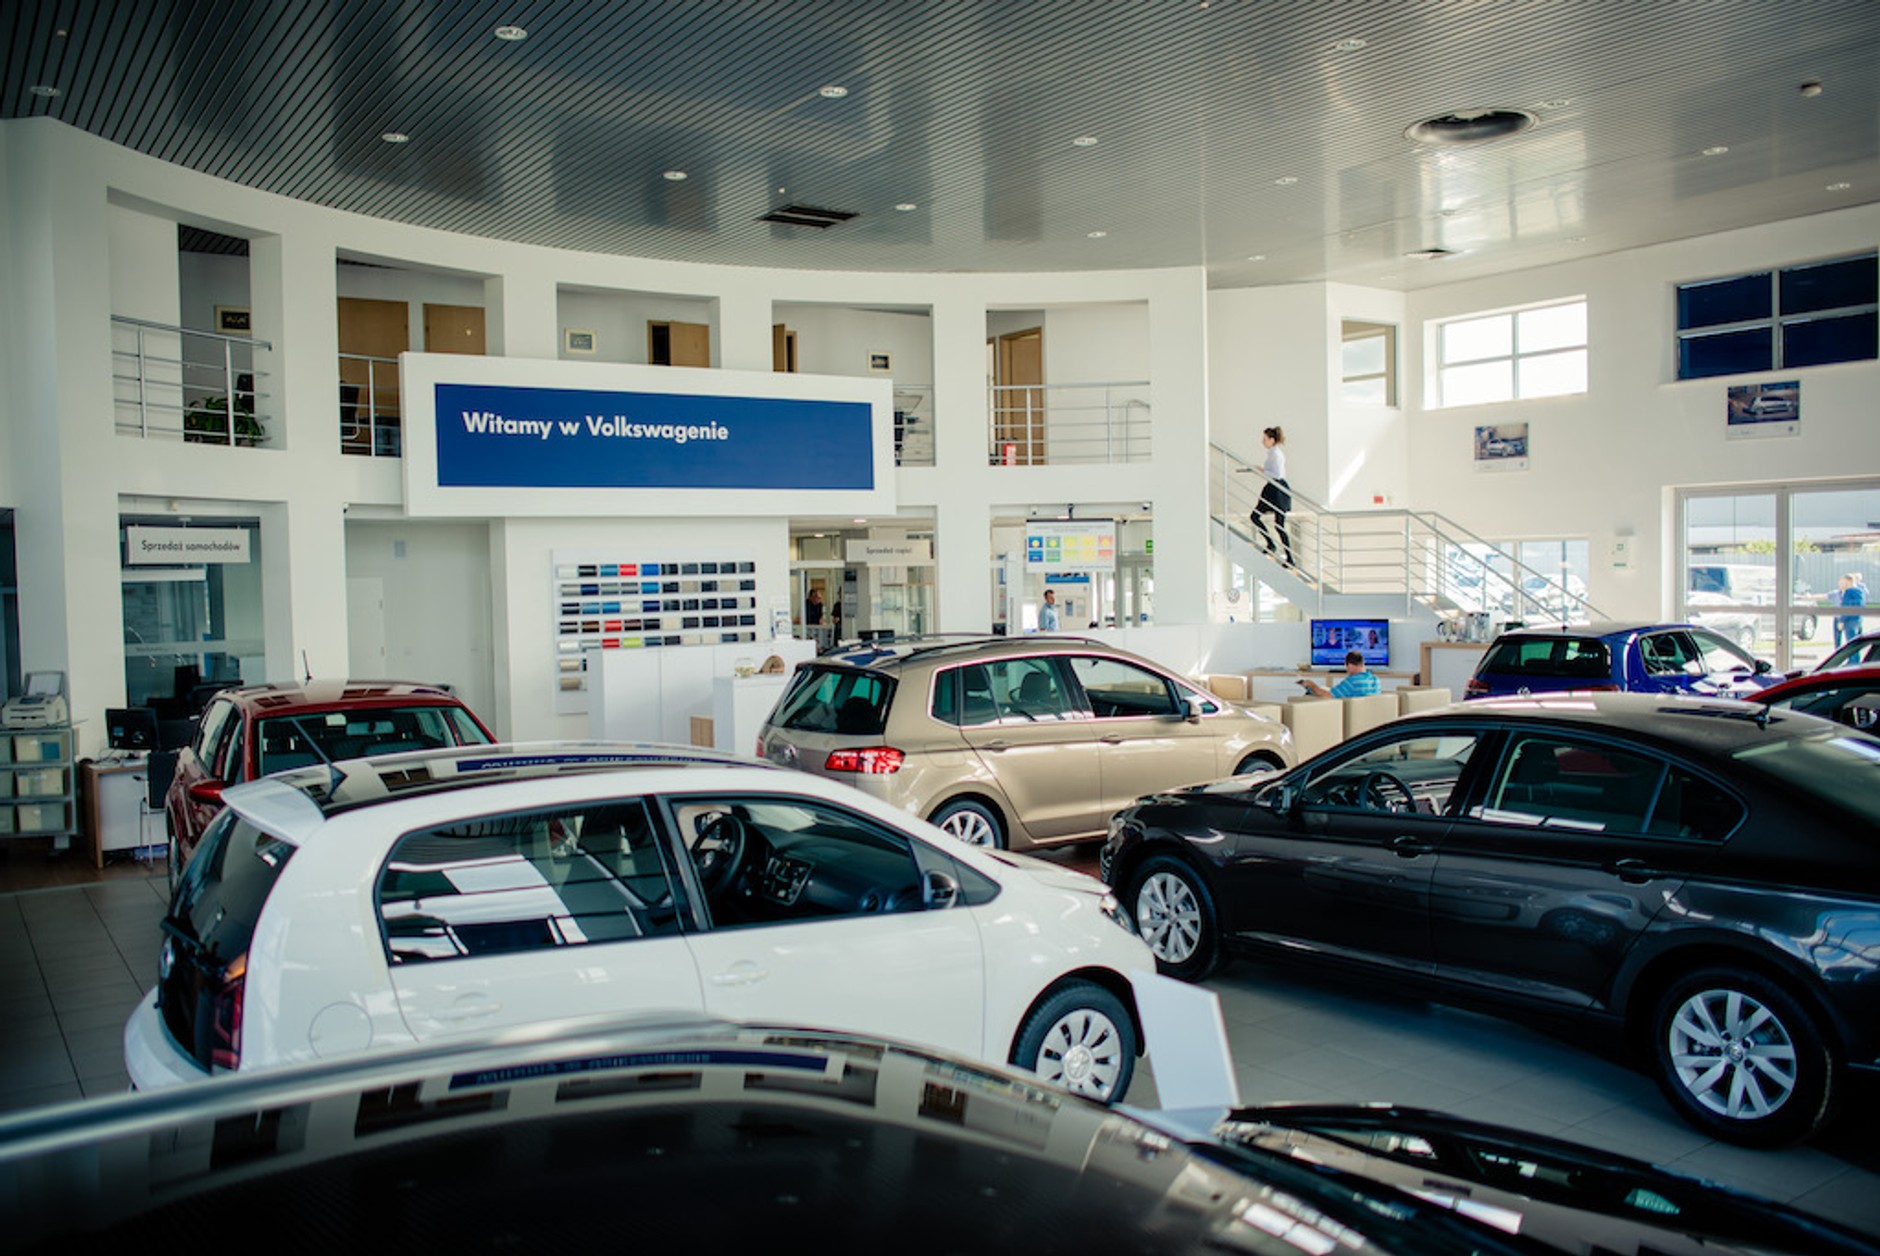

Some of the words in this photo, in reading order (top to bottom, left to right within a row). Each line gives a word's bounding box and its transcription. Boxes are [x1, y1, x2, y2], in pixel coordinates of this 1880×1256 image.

[462, 411, 552, 440] Witamy
[558, 420, 580, 436] w
[586, 415, 730, 444] Volkswagenie
[141, 540, 184, 552] Sprzedaż
